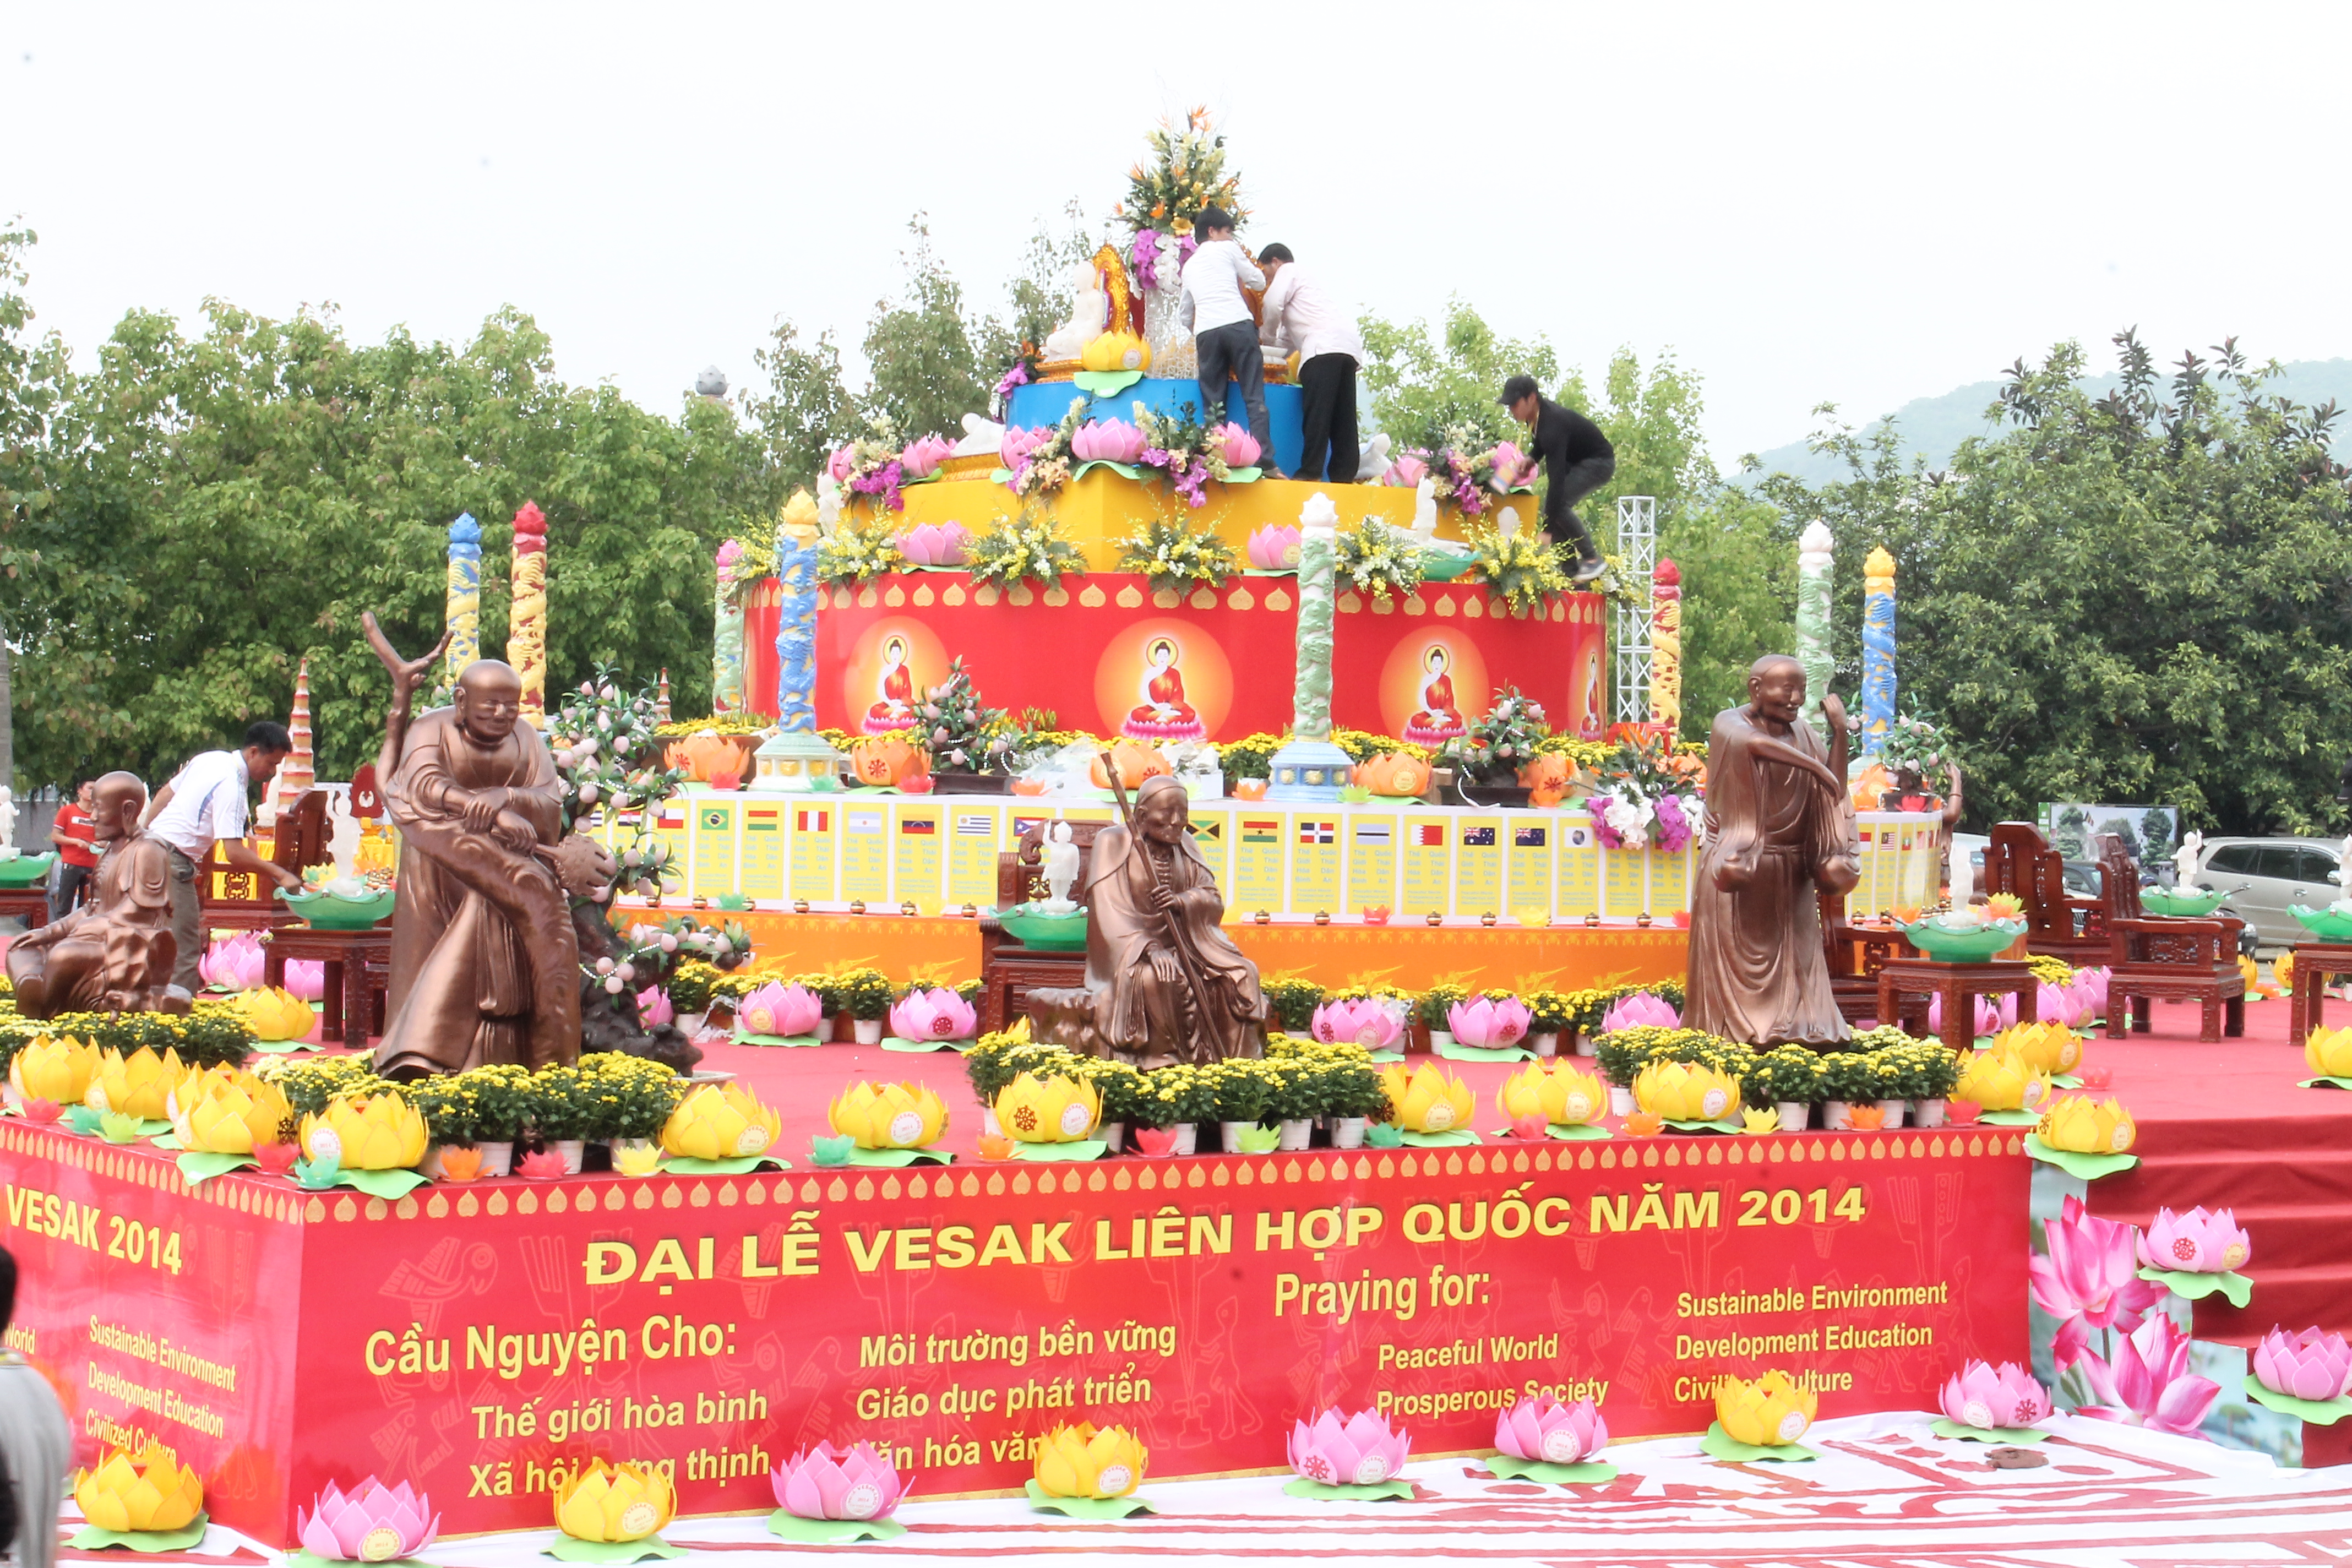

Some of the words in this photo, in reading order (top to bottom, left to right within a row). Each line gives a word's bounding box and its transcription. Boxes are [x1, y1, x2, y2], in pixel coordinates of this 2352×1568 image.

[5, 1183, 101, 1252] VESAK
[107, 1215, 183, 1276] 2014
[581, 1237, 715, 1295] ĐẠI
[741, 1210, 820, 1278] LỄ
[843, 1222, 1073, 1272] VESAK
[1095, 1206, 1233, 1261] LIÊN
[1255, 1205, 1383, 1262] HỢP
[1402, 1181, 1571, 1244] QUỐC
[1589, 1182, 1719, 1233] NĂM
[1737, 1187, 1866, 1227] 2014
[1275, 1268, 1417, 1325] Praying
[1428, 1264, 1490, 1307] for:
[1676, 1287, 1805, 1318] Sustainable
[1811, 1281, 1948, 1310] Environment
[89, 1314, 157, 1363] Sustainable
[159, 1337, 237, 1392] Environment
[364, 1321, 450, 1376] Cầu
[466, 1317, 627, 1380] Nguyện
[641, 1314, 736, 1360] Cho:
[859, 1333, 916, 1368] Môi
[925, 1329, 1028, 1367] trường
[1038, 1319, 1094, 1357] bền
[1103, 1320, 1176, 1358] vững
[1378, 1338, 1483, 1370] Peaceful
[1490, 1332, 1558, 1363] World
[1675, 1328, 1820, 1362] Development
[1825, 1322, 1932, 1351] Education
[88, 1360, 163, 1415] Development
[163, 1388, 224, 1439] Education
[471, 1396, 543, 1440] Thế
[548, 1397, 612, 1443] giới
[623, 1394, 685, 1429] hòa
[696, 1389, 767, 1424] bình
[856, 1386, 930, 1420] Giáo
[939, 1382, 997, 1422] dục
[1006, 1376, 1075, 1418] phát
[1083, 1361, 1151, 1406] triển
[1377, 1387, 1516, 1420] Prosperous
[85, 1407, 134, 1452] Civilized
[924, 1434, 981, 1468] hóa
[467, 1461, 513, 1498] Xã
[686, 1444, 769, 1488] thịnh
